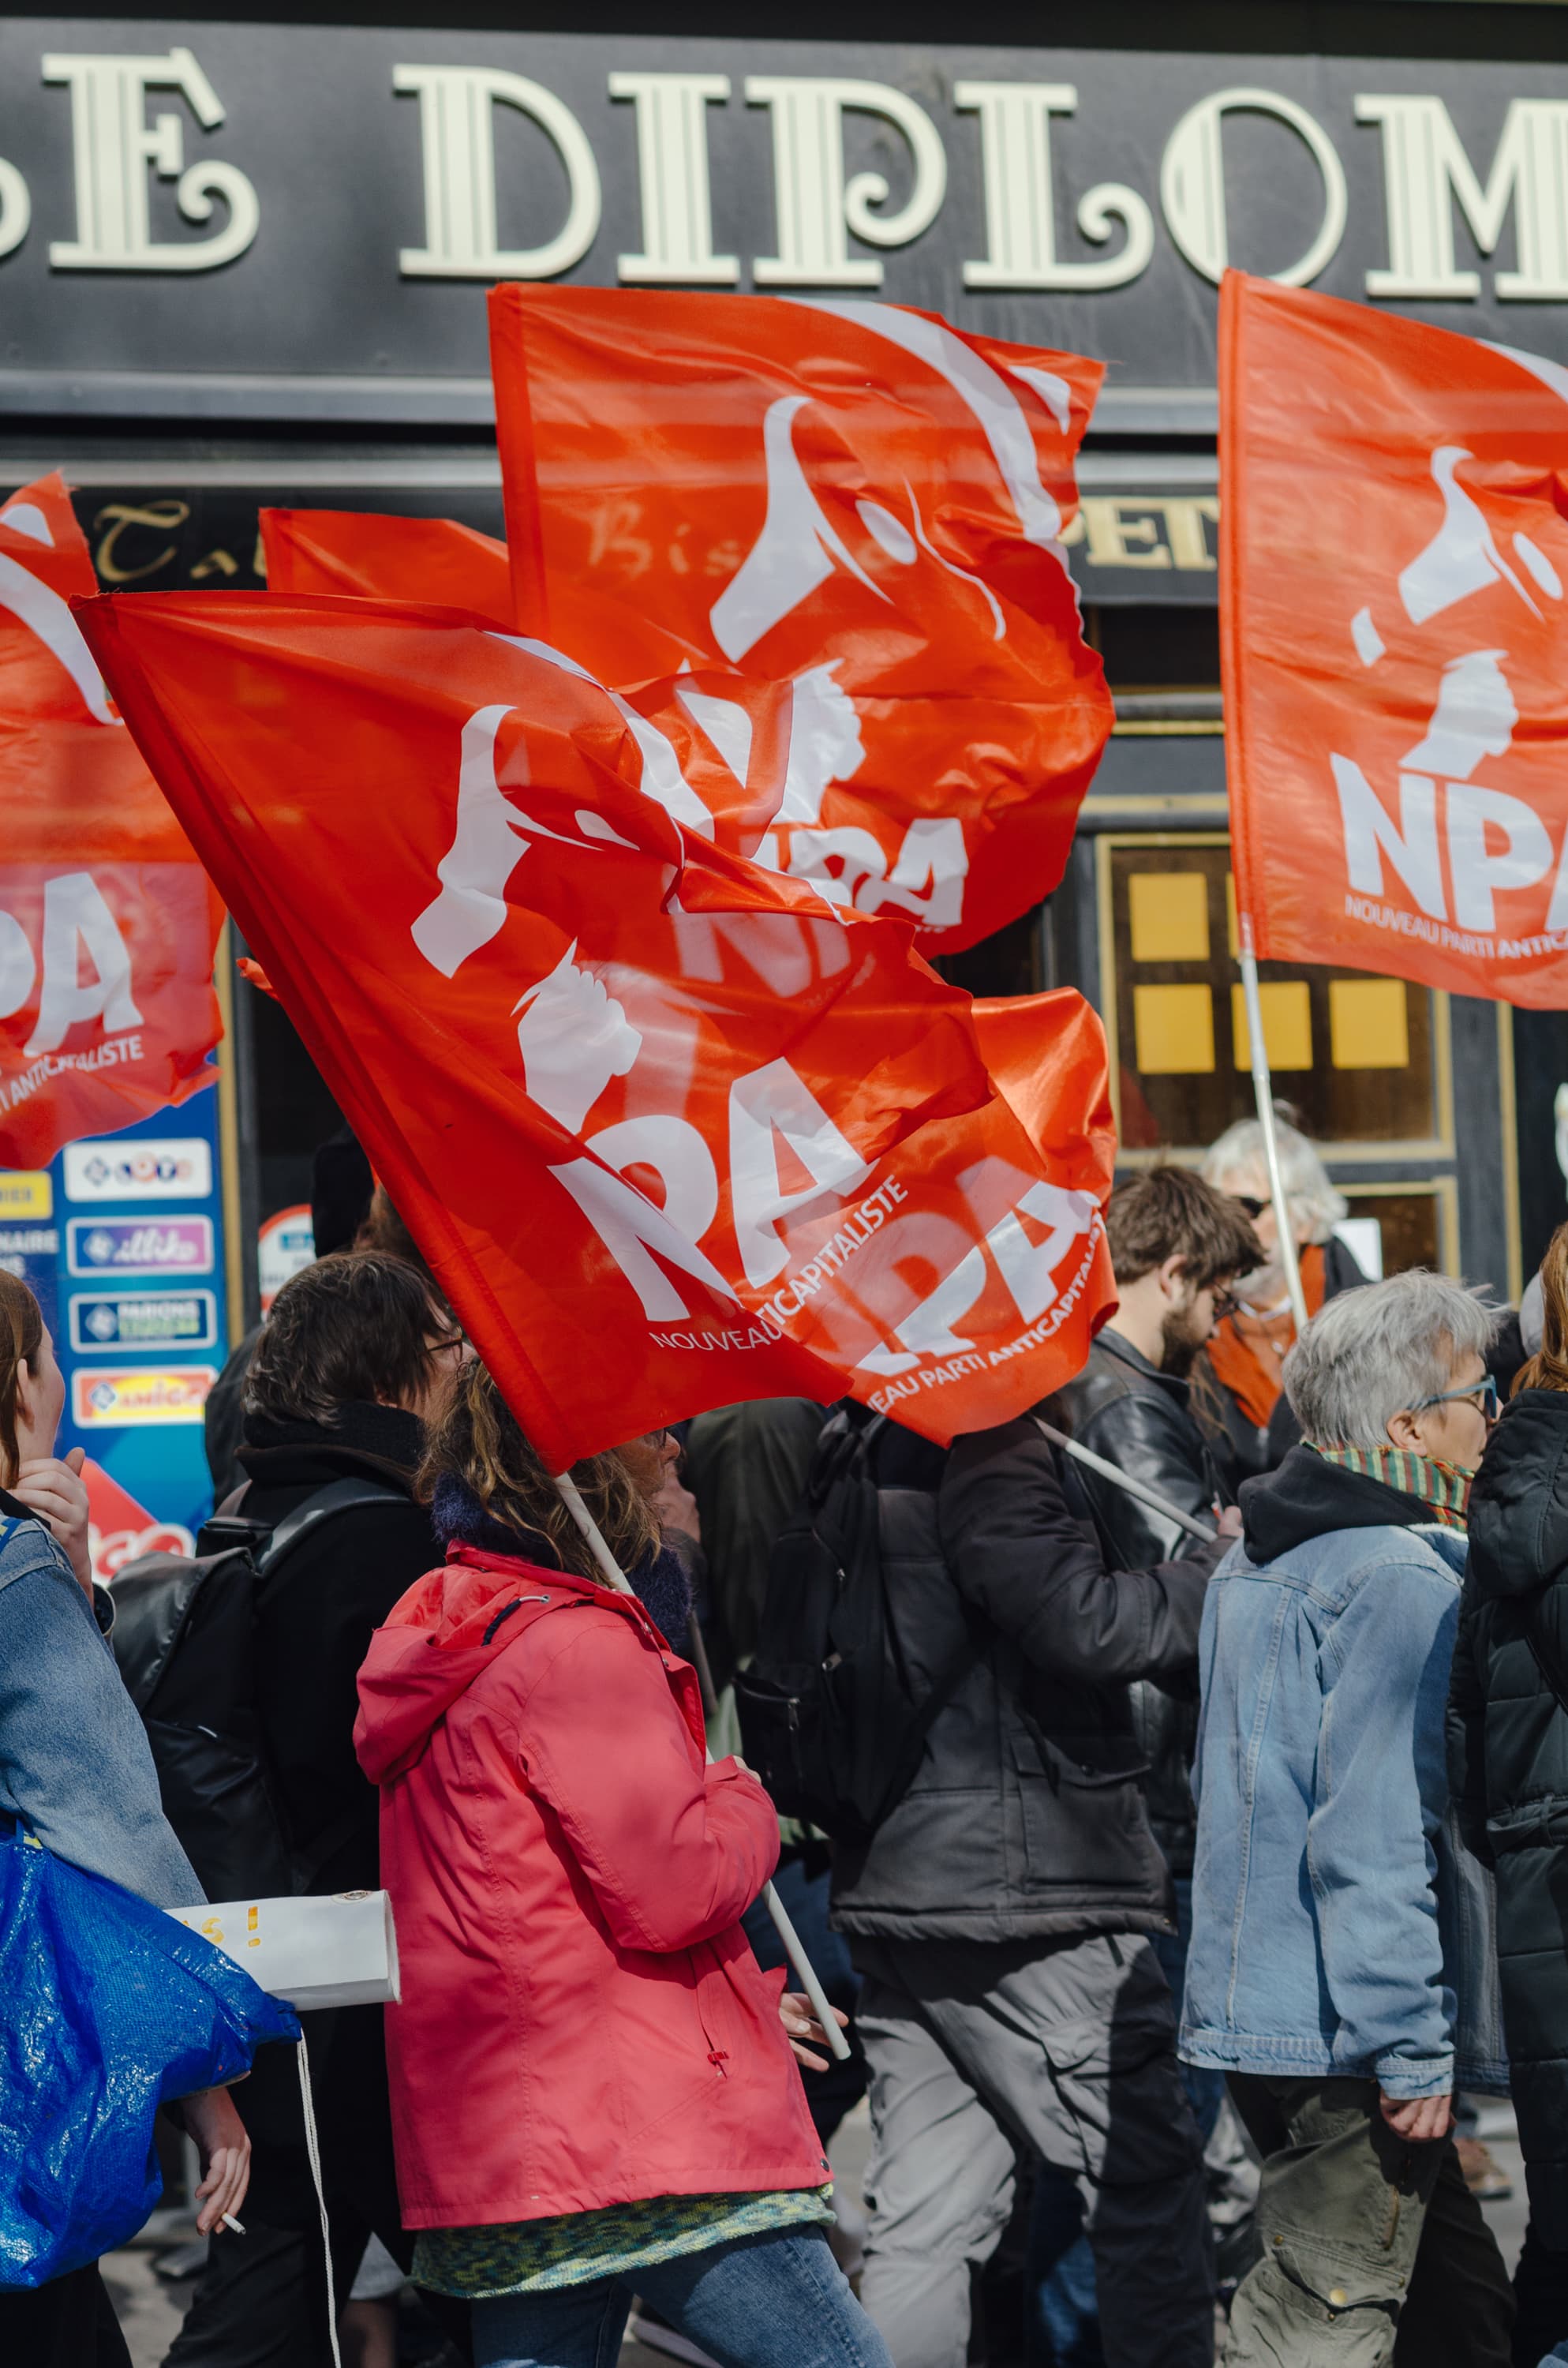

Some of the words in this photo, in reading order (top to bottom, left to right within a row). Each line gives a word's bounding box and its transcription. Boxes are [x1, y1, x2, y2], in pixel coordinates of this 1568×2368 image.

[0, 47, 260, 271] E
[1329, 751, 1568, 932] NP
[1345, 893, 1439, 944] NOUVEAU
[1440, 926, 1495, 960] PARTI
[918, 1353, 988, 1389] PARTI
